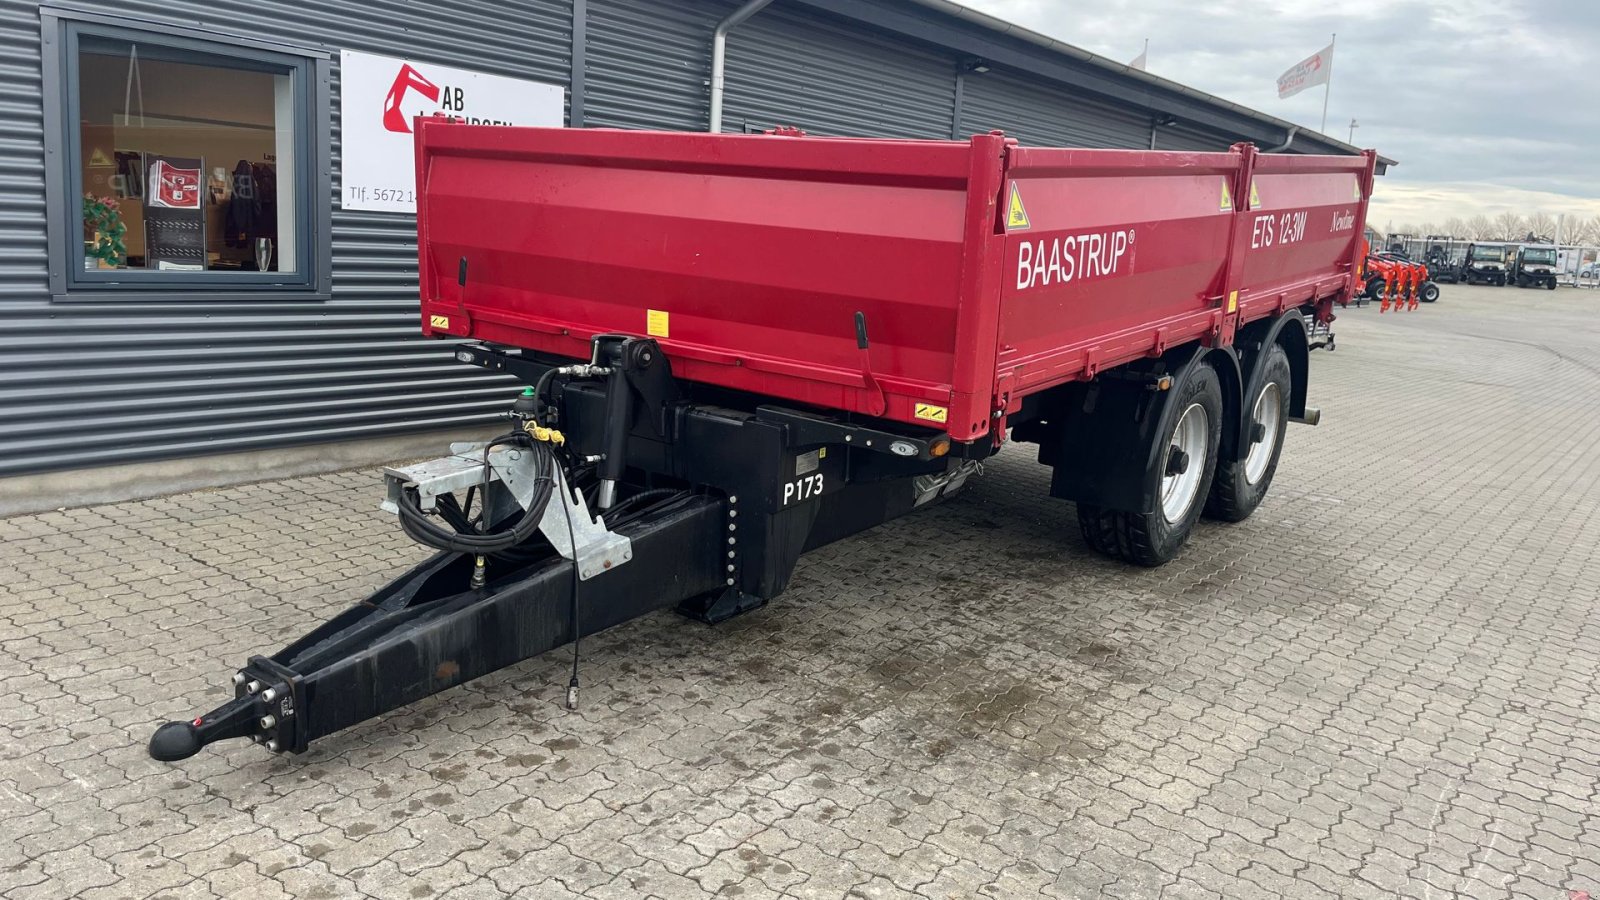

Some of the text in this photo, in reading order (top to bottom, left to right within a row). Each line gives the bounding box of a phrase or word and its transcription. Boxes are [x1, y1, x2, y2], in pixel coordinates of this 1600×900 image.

[442, 86, 464, 111] AB
[350, 186, 369, 203] Tlf.
[374, 188, 403, 202] 5672
[1252, 214, 1275, 249] ETS
[1279, 211, 1308, 244] 12-3W
[783, 473, 824, 505] P173
